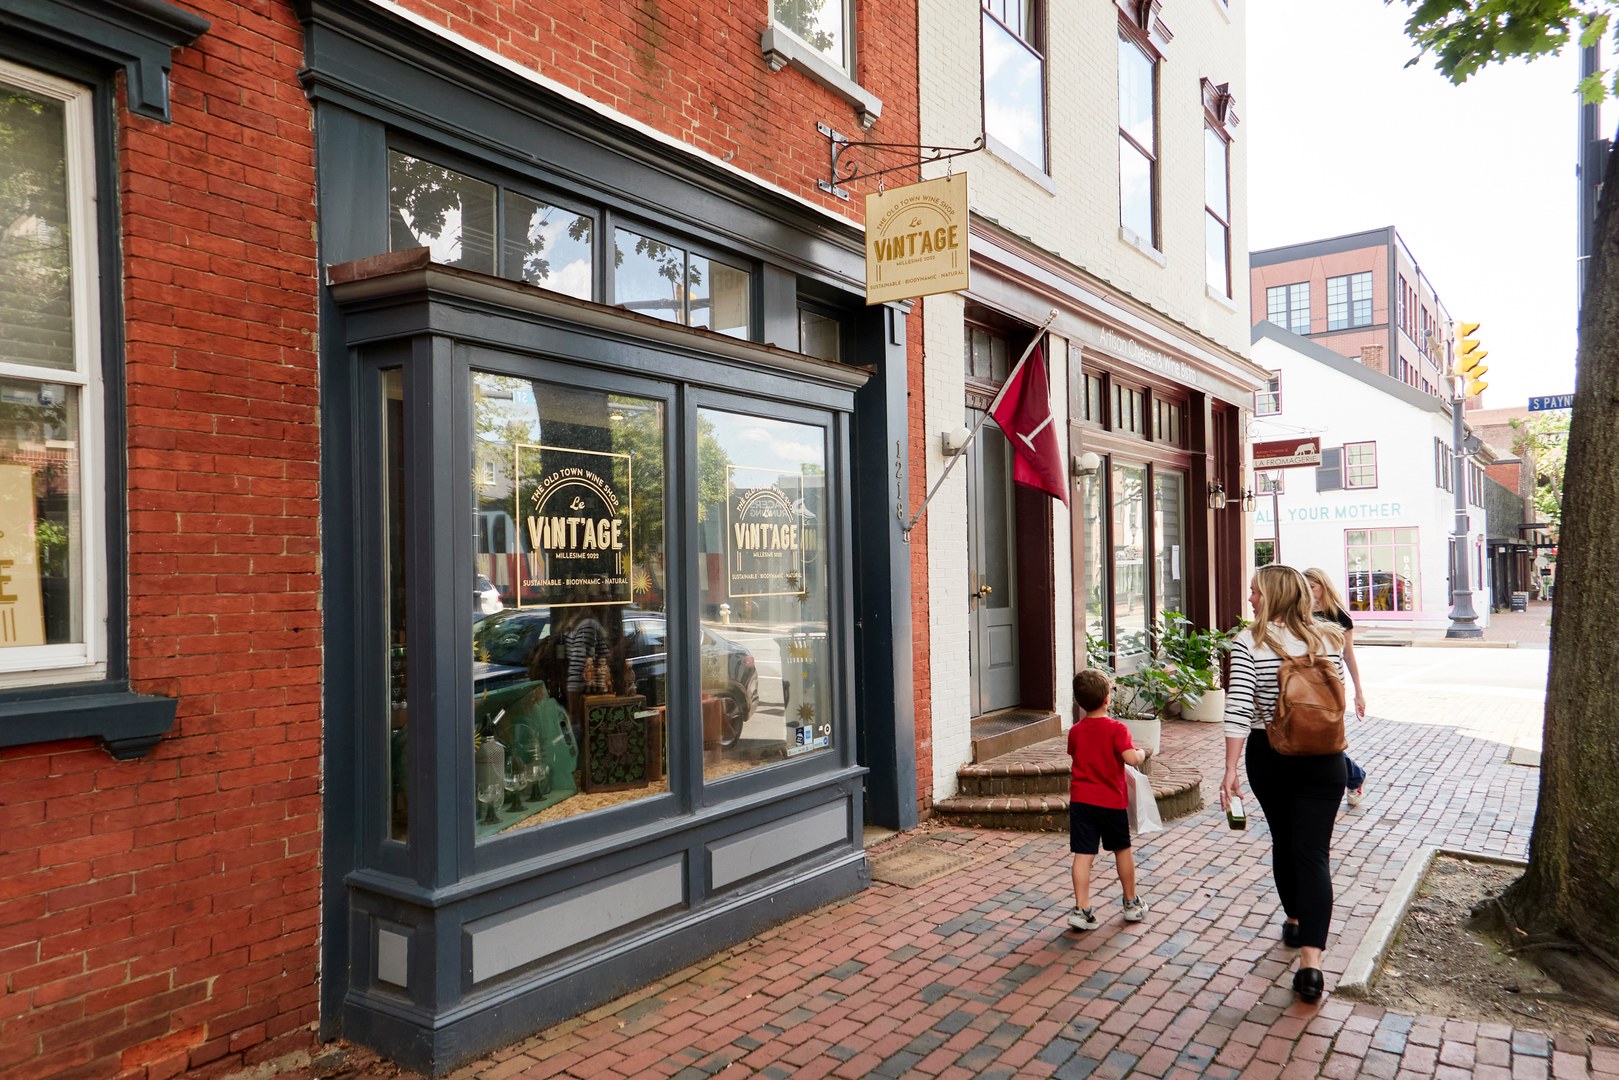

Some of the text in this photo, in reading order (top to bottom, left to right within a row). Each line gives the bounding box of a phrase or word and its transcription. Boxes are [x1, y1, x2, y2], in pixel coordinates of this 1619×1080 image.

[877, 195, 955, 230] THE OLD TOWN WINE SHOP
[909, 217, 922, 228] Le
[870, 270, 964, 290] SUSTAINABLE BIODYNAMIC NATURAL
[1534, 399, 1539, 409] S
[1267, 456, 1317, 466] FROMAGERIE
[531, 468, 619, 506] THE OLD TOWN WINE SHOP
[570, 496, 585, 510] Le
[1288, 506, 1329, 520] YOUR
[1335, 503, 1401, 518] MOTHER
[528, 516, 622, 550] VINT'AGE
